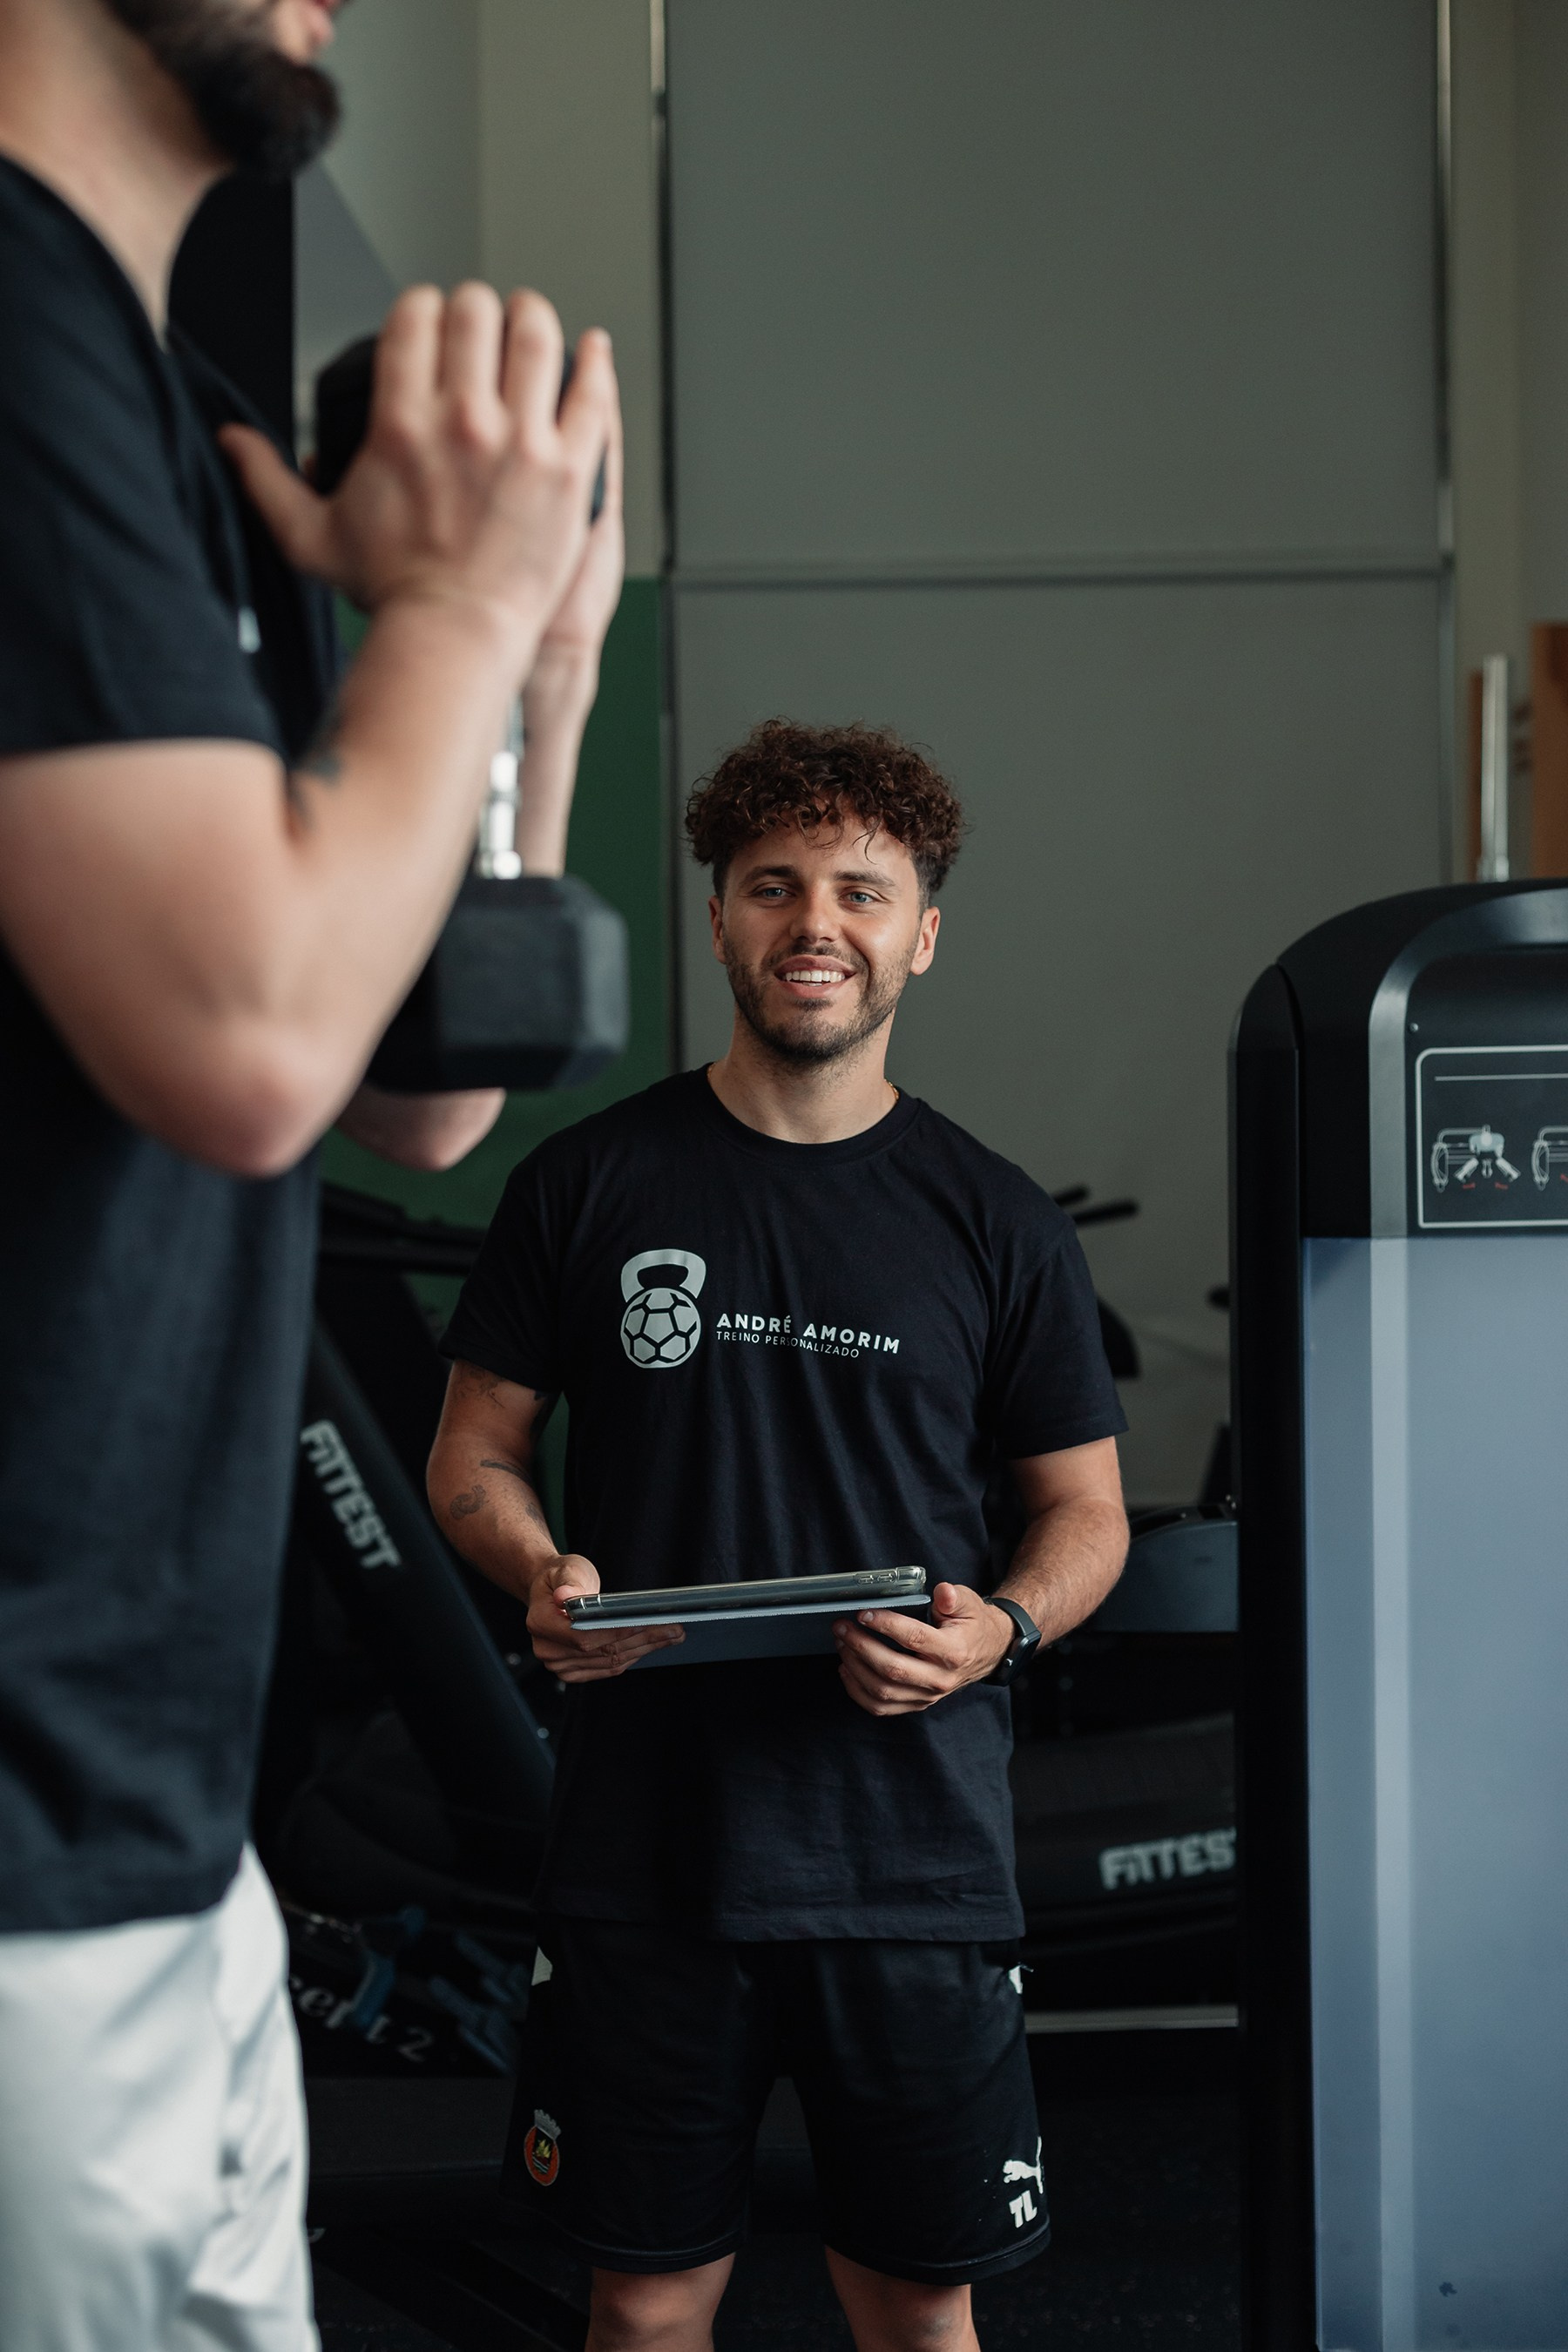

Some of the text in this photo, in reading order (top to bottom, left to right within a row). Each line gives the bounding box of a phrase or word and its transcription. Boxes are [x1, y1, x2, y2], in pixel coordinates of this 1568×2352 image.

[716, 1313, 900, 1354] ANDRÉ AMORIM
[716, 1330, 860, 1358] TREINO PERSONALIZADO
[1099, 1827, 1237, 1890] FITTES
[1009, 2189, 1037, 2228] TL
